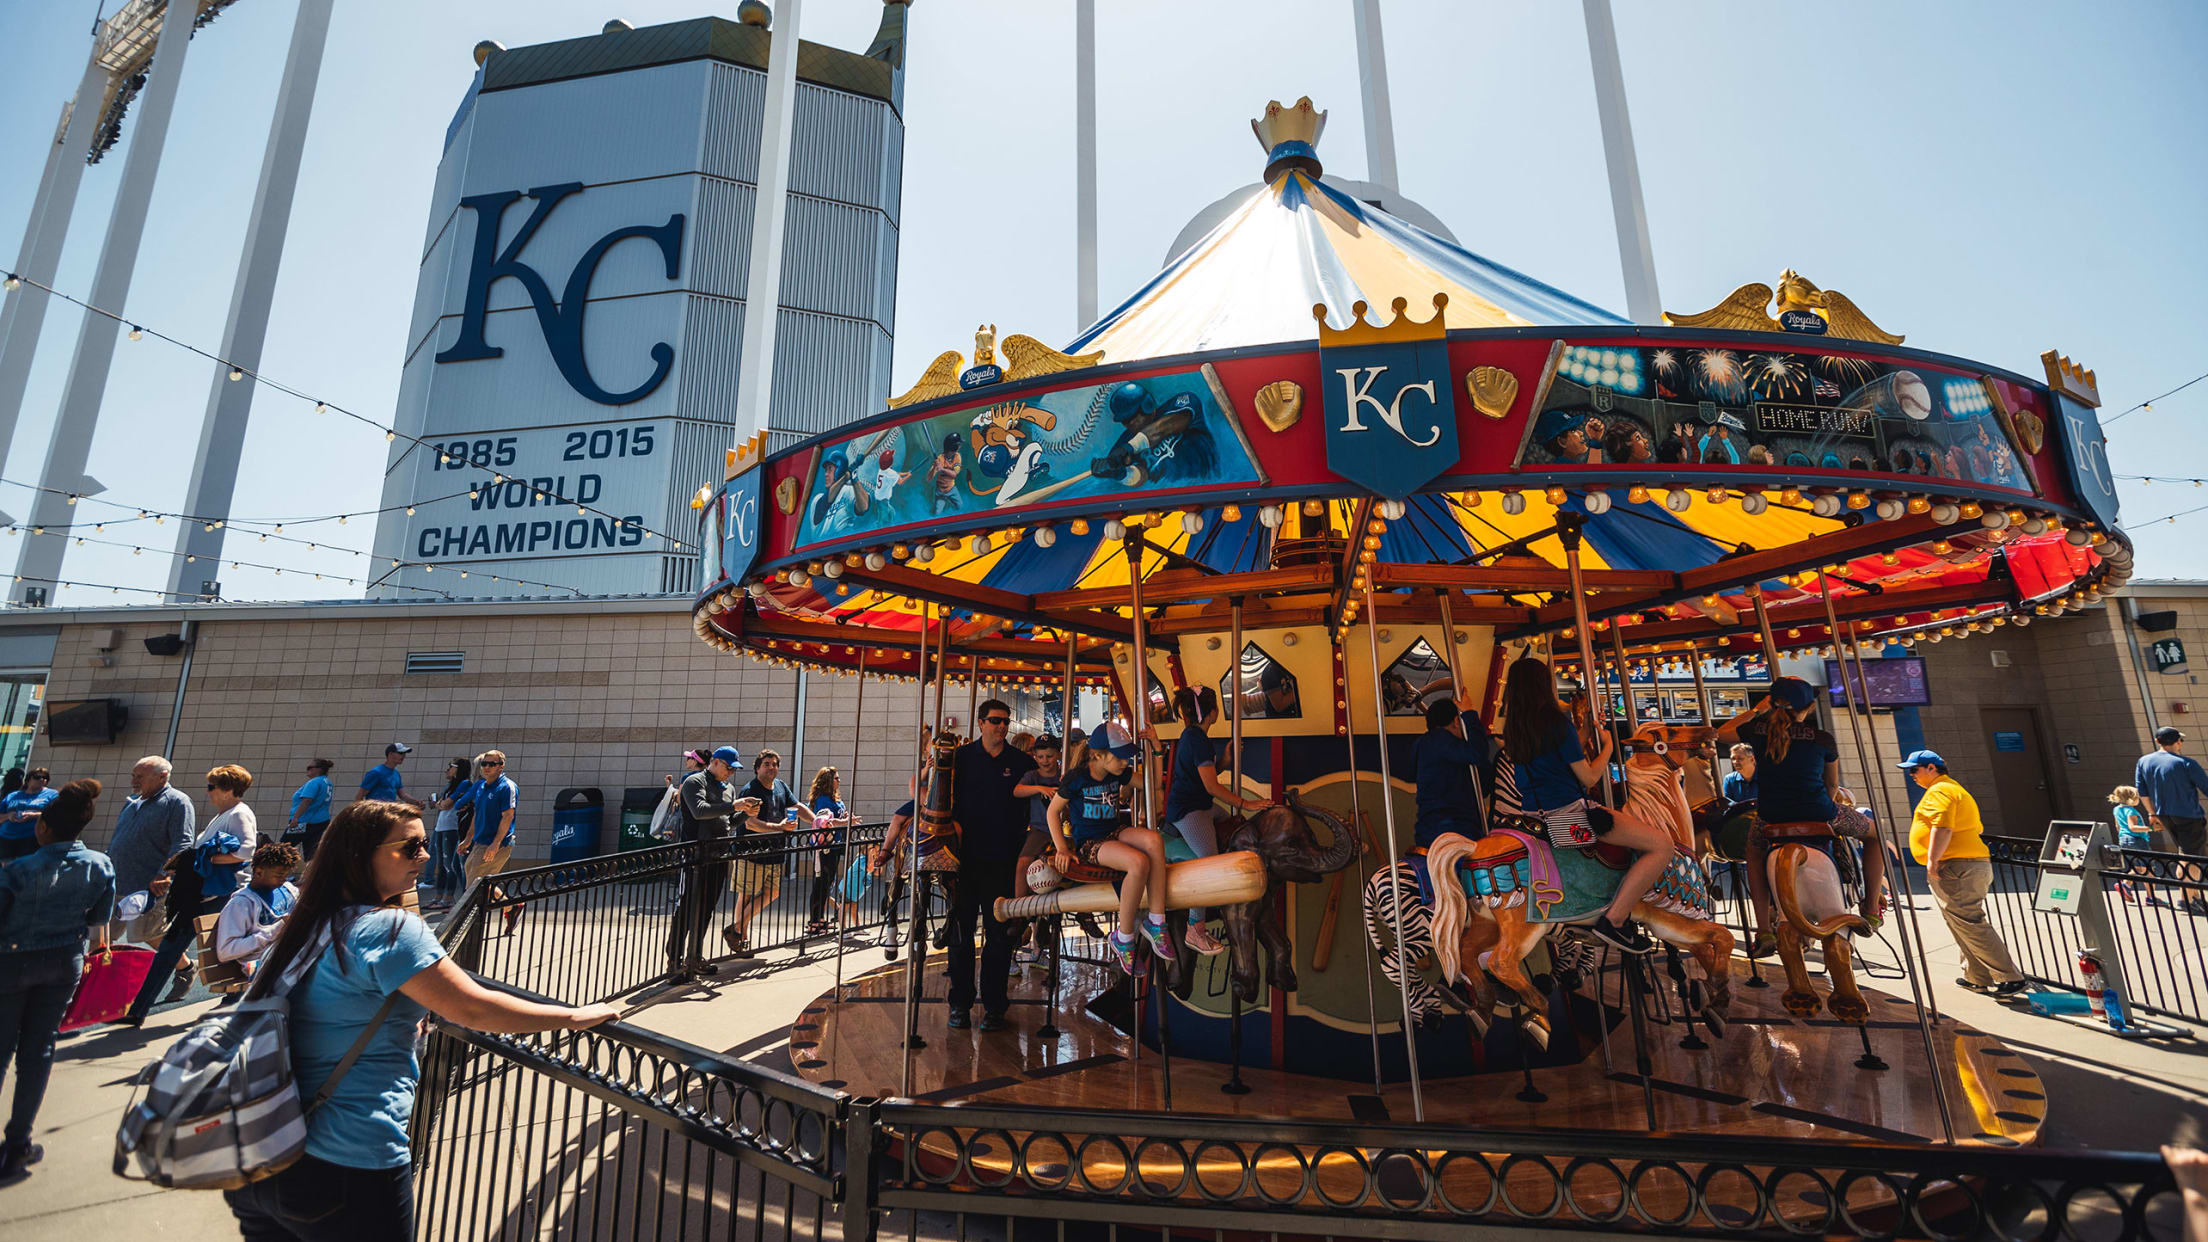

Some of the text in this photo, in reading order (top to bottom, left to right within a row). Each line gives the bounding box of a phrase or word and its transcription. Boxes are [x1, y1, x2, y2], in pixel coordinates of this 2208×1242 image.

[435, 182, 684, 406] KC
[1787, 312, 1822, 330] Royals
[966, 366, 996, 385] Royals
[1335, 365, 1441, 447] KC
[1761, 407, 1868, 433] HOME RUN!
[433, 426, 654, 471] 1985 2015
[2067, 415, 2112, 497] KC
[470, 474, 601, 511] WORLD
[876, 474, 884, 490] 5
[418, 515, 643, 558] CHAMPIONS
[726, 490, 755, 547] KC
[1101, 791, 1115, 807] KC
